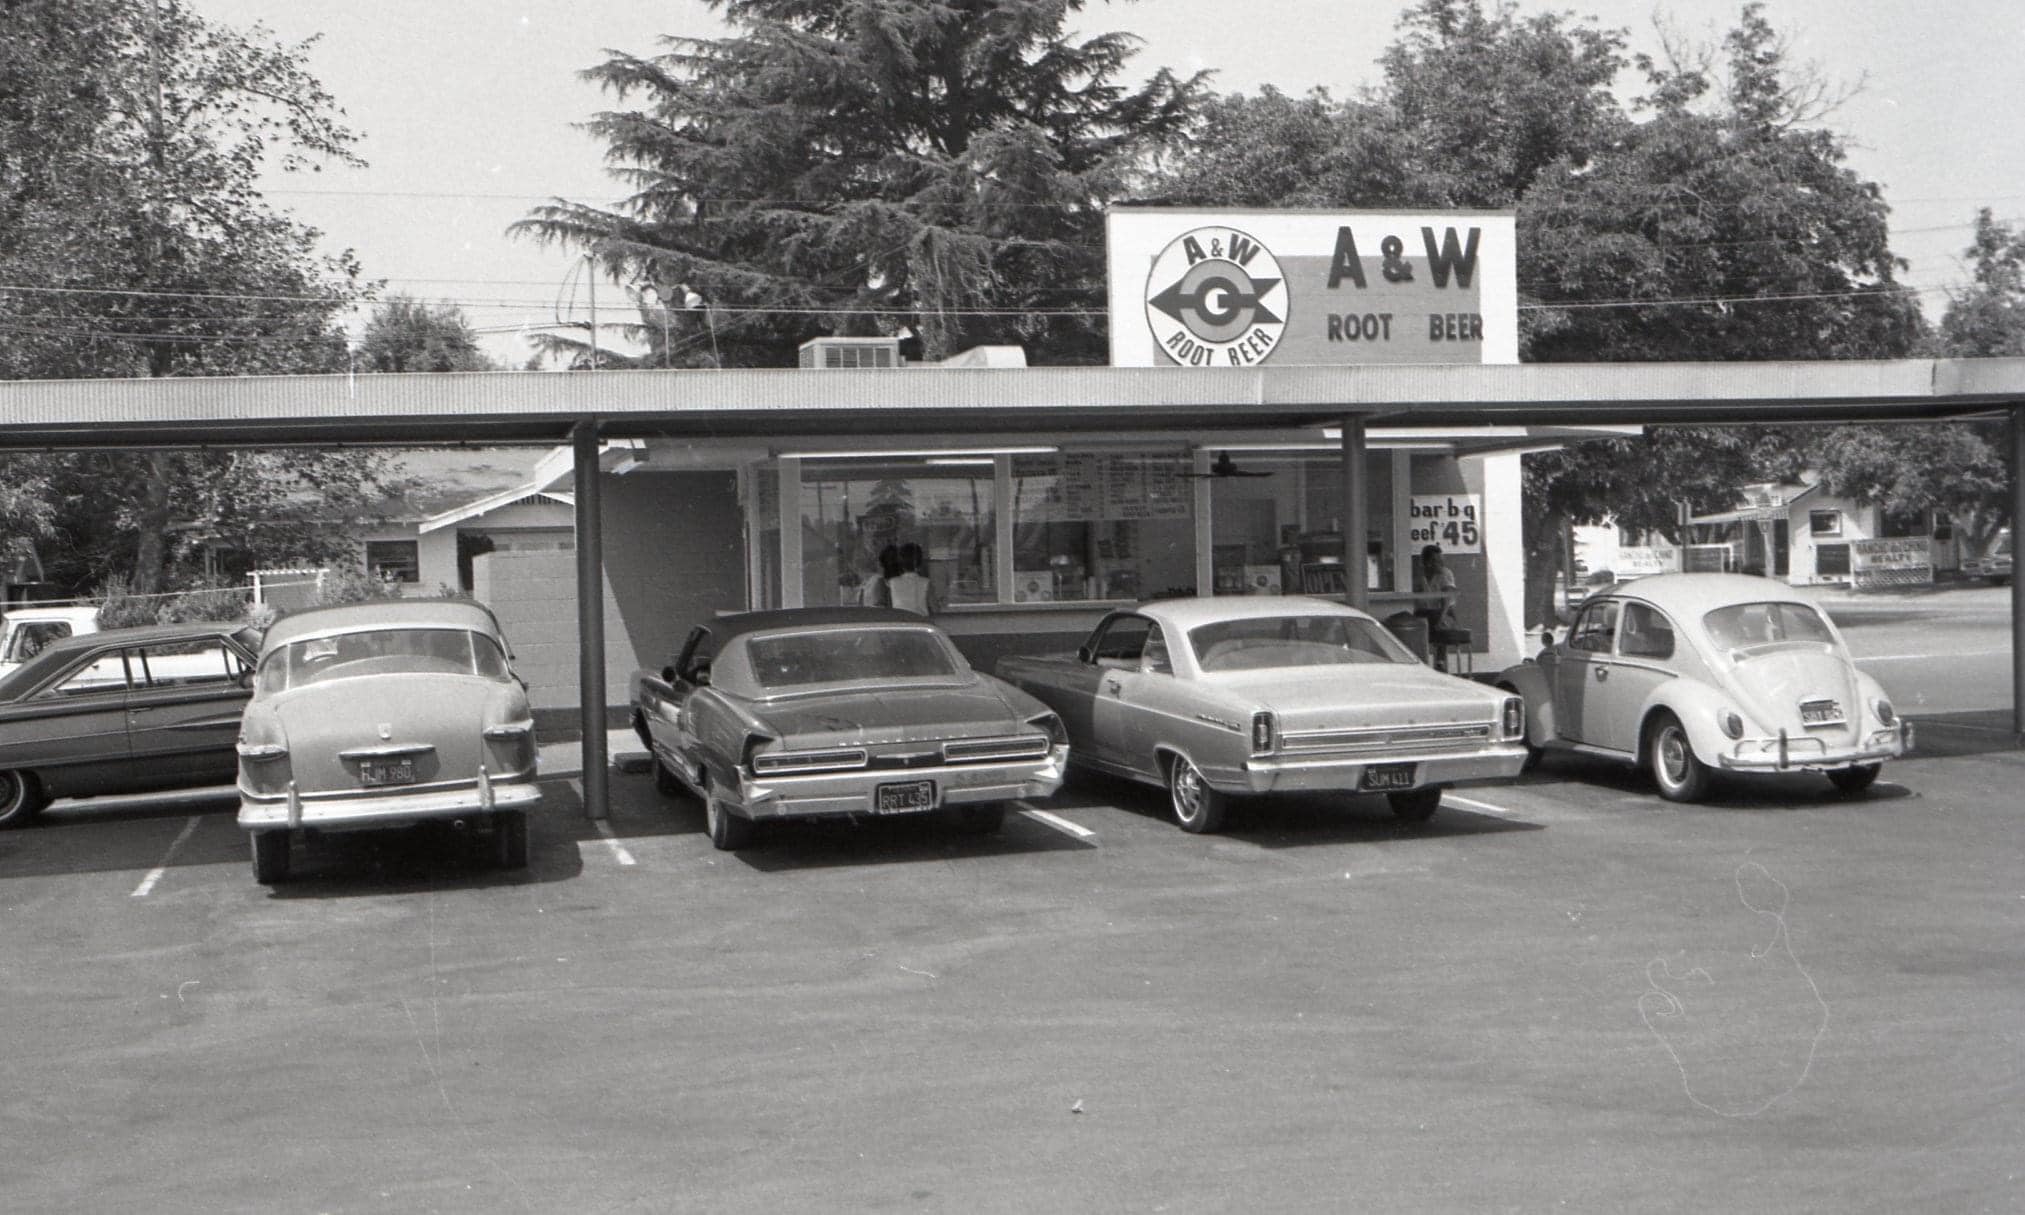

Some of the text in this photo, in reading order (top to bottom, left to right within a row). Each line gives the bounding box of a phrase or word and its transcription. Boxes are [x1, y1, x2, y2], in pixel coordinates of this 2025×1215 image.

[1327, 226, 1481, 289] A & W
[1327, 313, 1483, 341] ROOT BEER
[1166, 328, 1273, 366] ROOT BEER
[1410, 497, 1443, 517] bar
